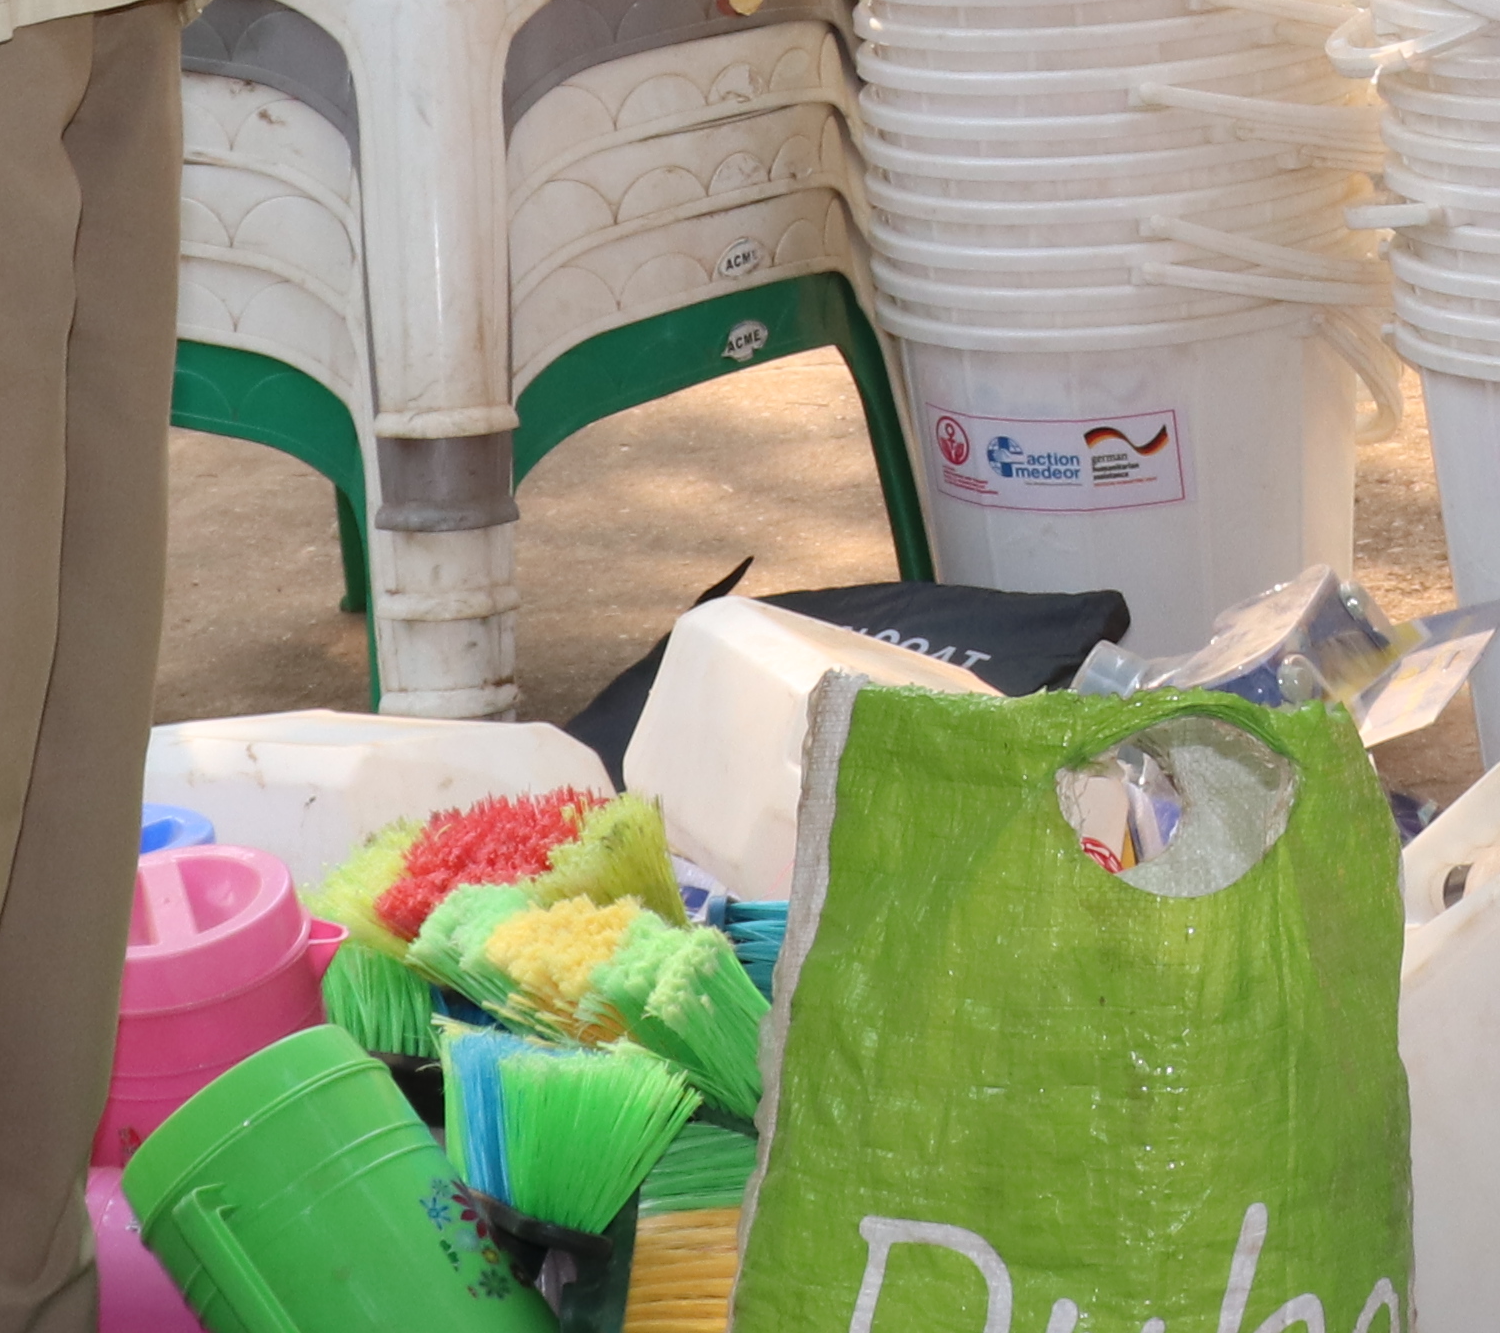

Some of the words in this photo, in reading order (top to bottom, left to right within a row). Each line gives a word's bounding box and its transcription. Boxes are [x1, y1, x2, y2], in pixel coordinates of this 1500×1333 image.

[727, 328, 762, 353] ACME
[1026, 451, 1081, 467] action
[1015, 466, 1081, 480] medeor
